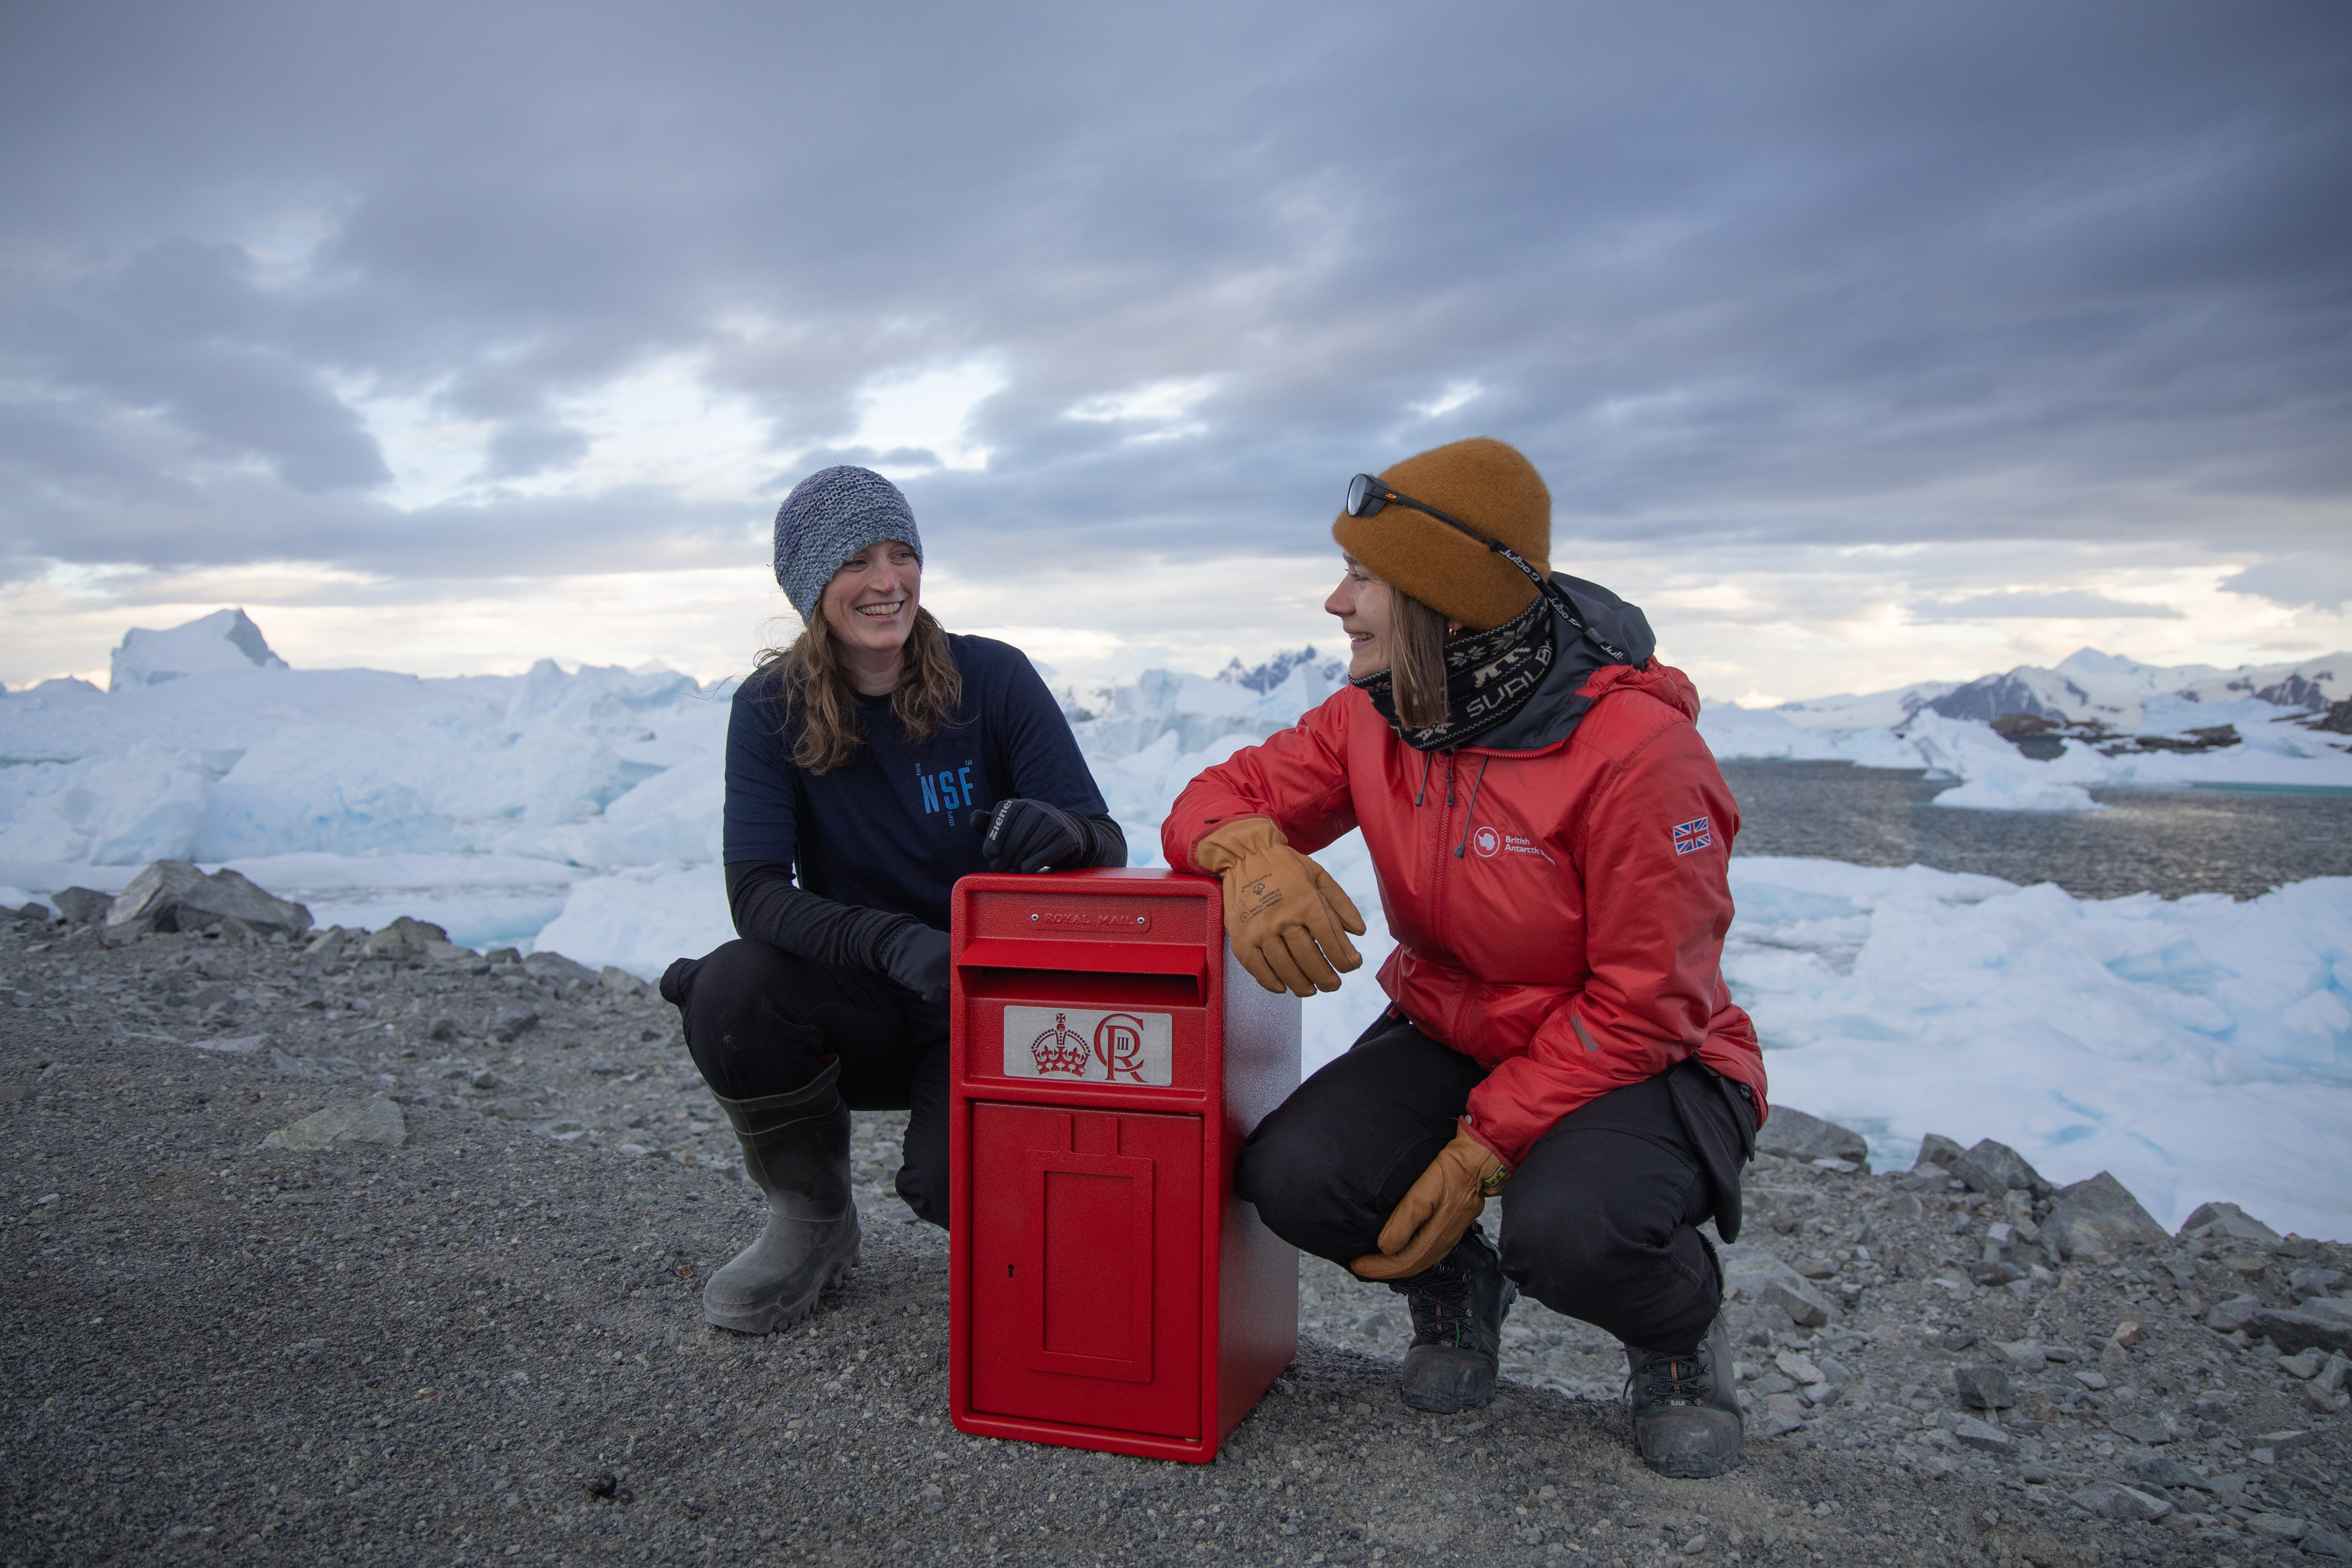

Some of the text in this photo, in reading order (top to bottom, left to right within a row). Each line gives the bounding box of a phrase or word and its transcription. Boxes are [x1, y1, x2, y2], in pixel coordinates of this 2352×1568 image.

[921, 767, 973, 814] NSF
[1506, 835, 1530, 845] British
[1504, 844, 1541, 854] Antarctic
[1044, 913, 1134, 926] ROYAL MAIL
